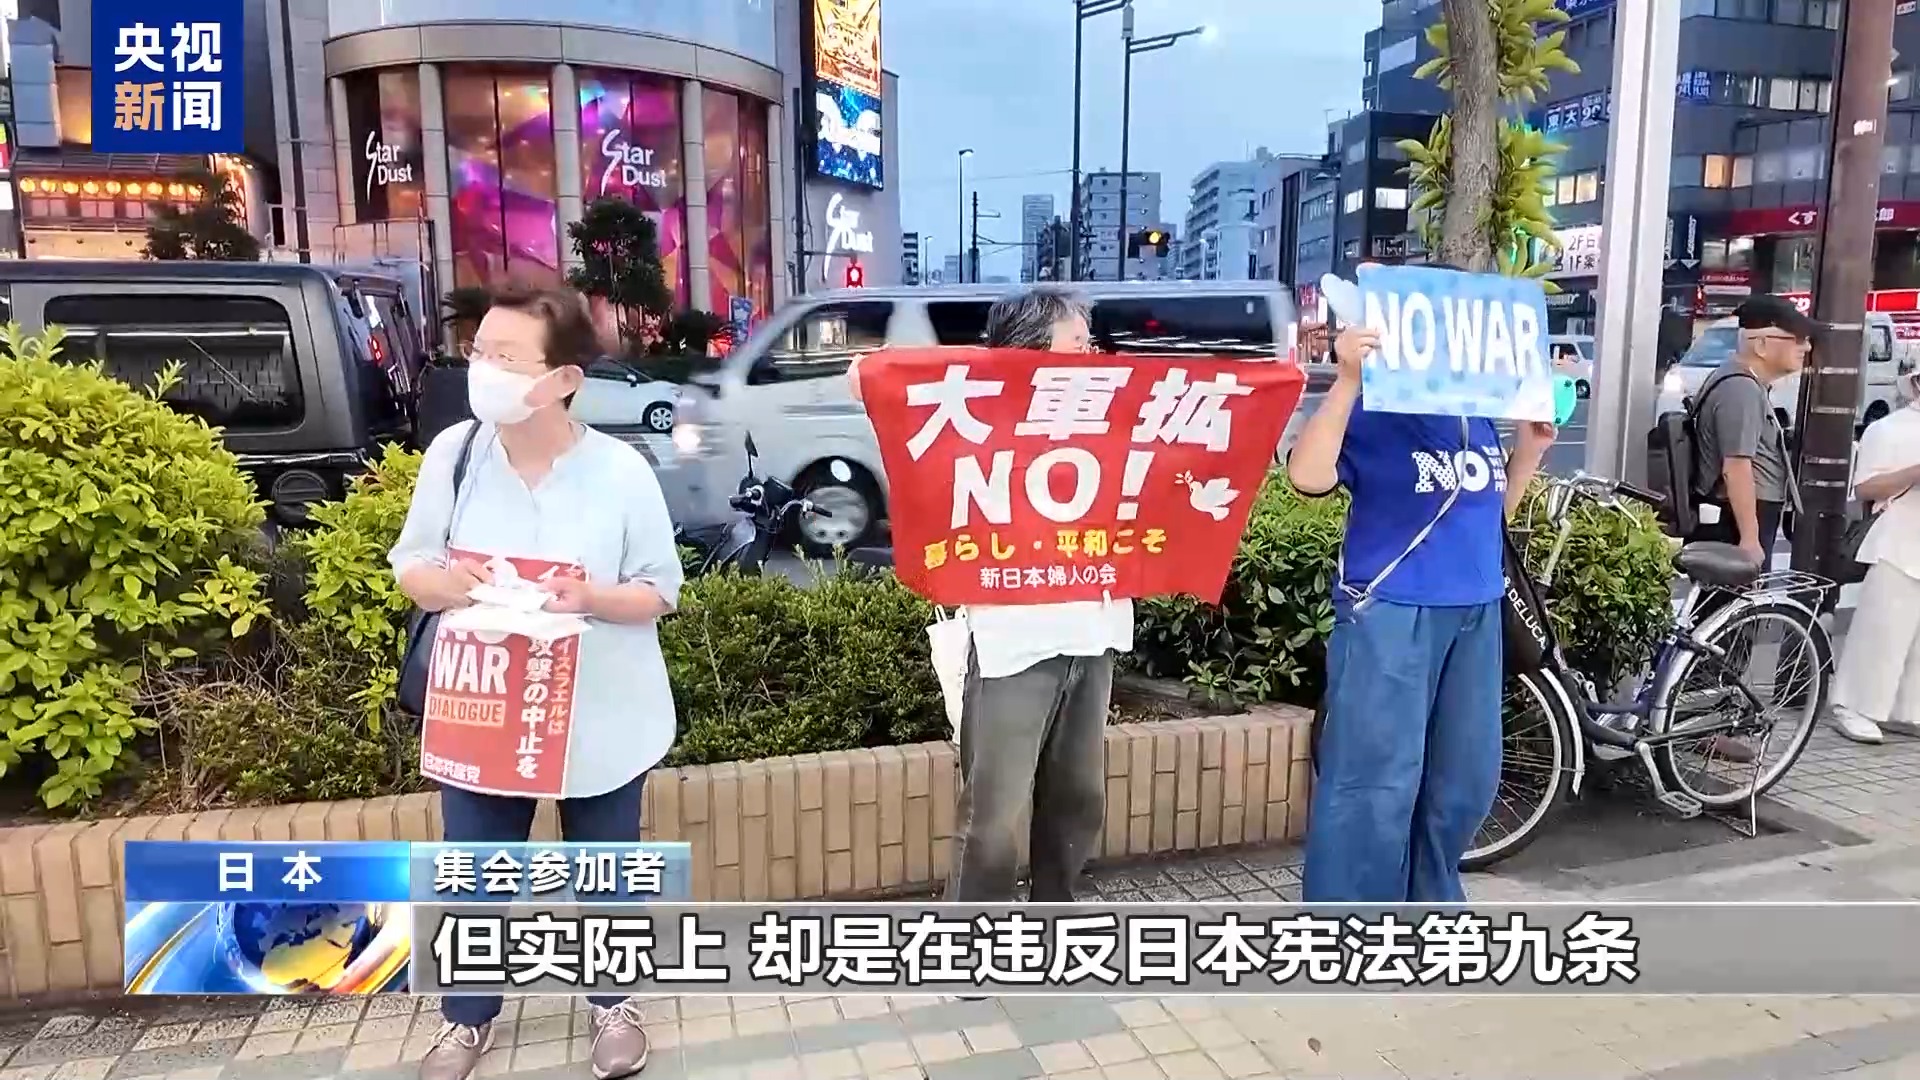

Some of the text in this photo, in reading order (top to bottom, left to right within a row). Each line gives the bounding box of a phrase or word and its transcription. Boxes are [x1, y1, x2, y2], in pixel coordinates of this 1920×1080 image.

[366, 131, 400, 201] Star
[377, 163, 412, 183] Dust
[601, 129, 653, 196] Star
[623, 165, 667, 188] Dust
[842, 230, 873, 253] Dust
[1363, 290, 1544, 378] NO WAR
[906, 365, 1256, 460] 大軍拡
[950, 447, 1155, 529] NO!
[1411, 450, 1490, 492] NO
[980, 564, 1117, 590] 新日本婦人の会
[1507, 588, 1547, 651] DELUCA
[434, 640, 510, 695] WAR
[428, 696, 503, 723] DIALOGUE
